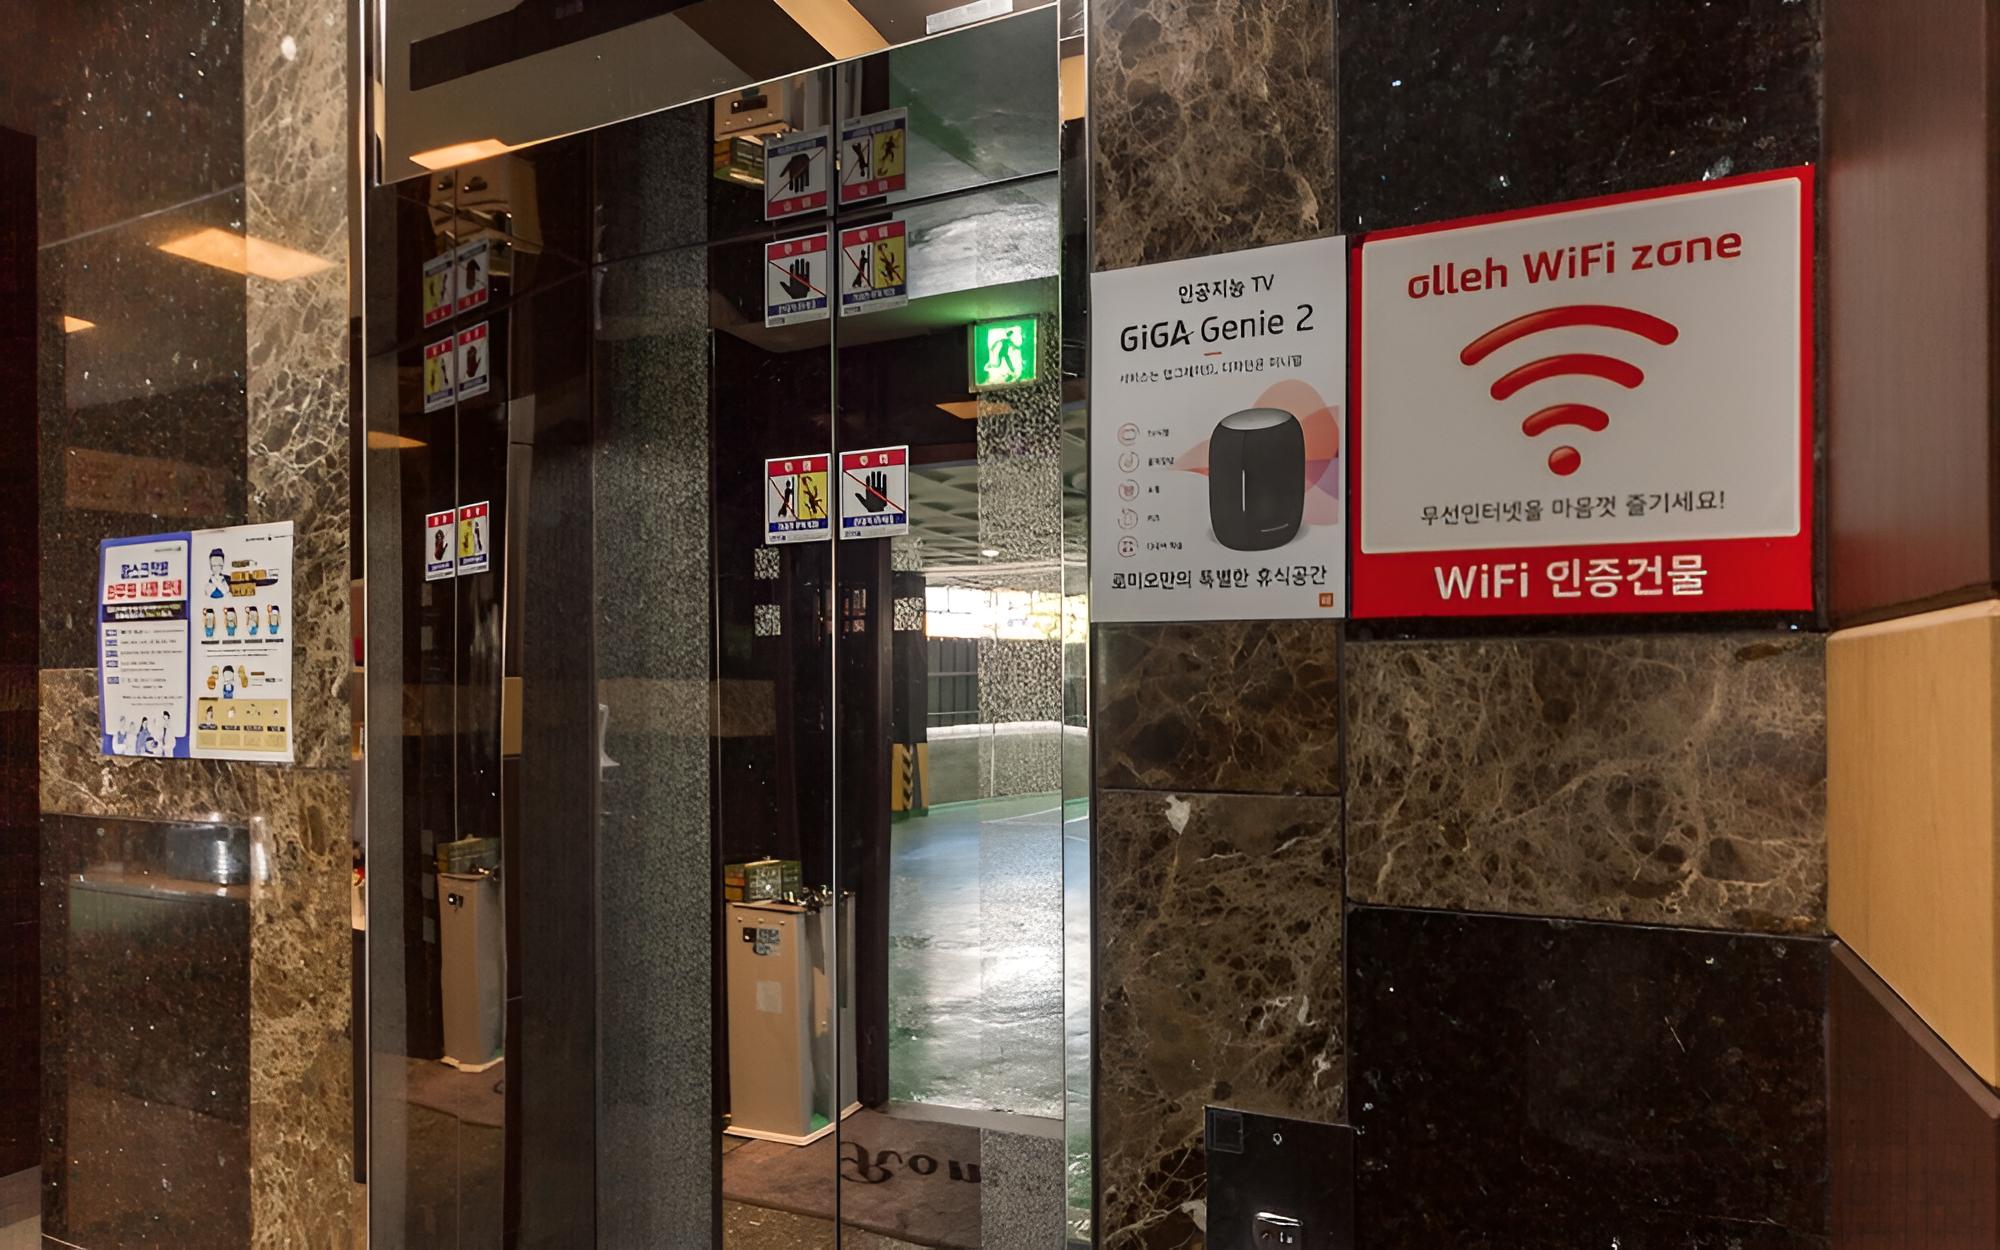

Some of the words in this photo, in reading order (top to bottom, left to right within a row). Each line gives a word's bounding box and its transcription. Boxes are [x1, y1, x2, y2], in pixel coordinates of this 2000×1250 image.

[1407, 260, 1508, 299] olleh
[1523, 241, 1616, 283] WiFi
[1631, 232, 1743, 271] zone
[1178, 278, 1245, 304] 인공지능
[1251, 274, 1275, 293] TV
[1120, 320, 1194, 352] GiGA
[1200, 310, 1284, 343] Genie
[1296, 303, 1314, 332] 2
[1420, 498, 1543, 526] 무선인터넷을
[1552, 495, 1617, 520] 마음껏
[1626, 490, 1726, 516] 즐기세요!
[1111, 570, 1192, 590] 로미오만의
[1256, 565, 1327, 587] 휴식공간
[1434, 562, 1529, 600] WiFi
[1546, 555, 1708, 598] 인증건물
